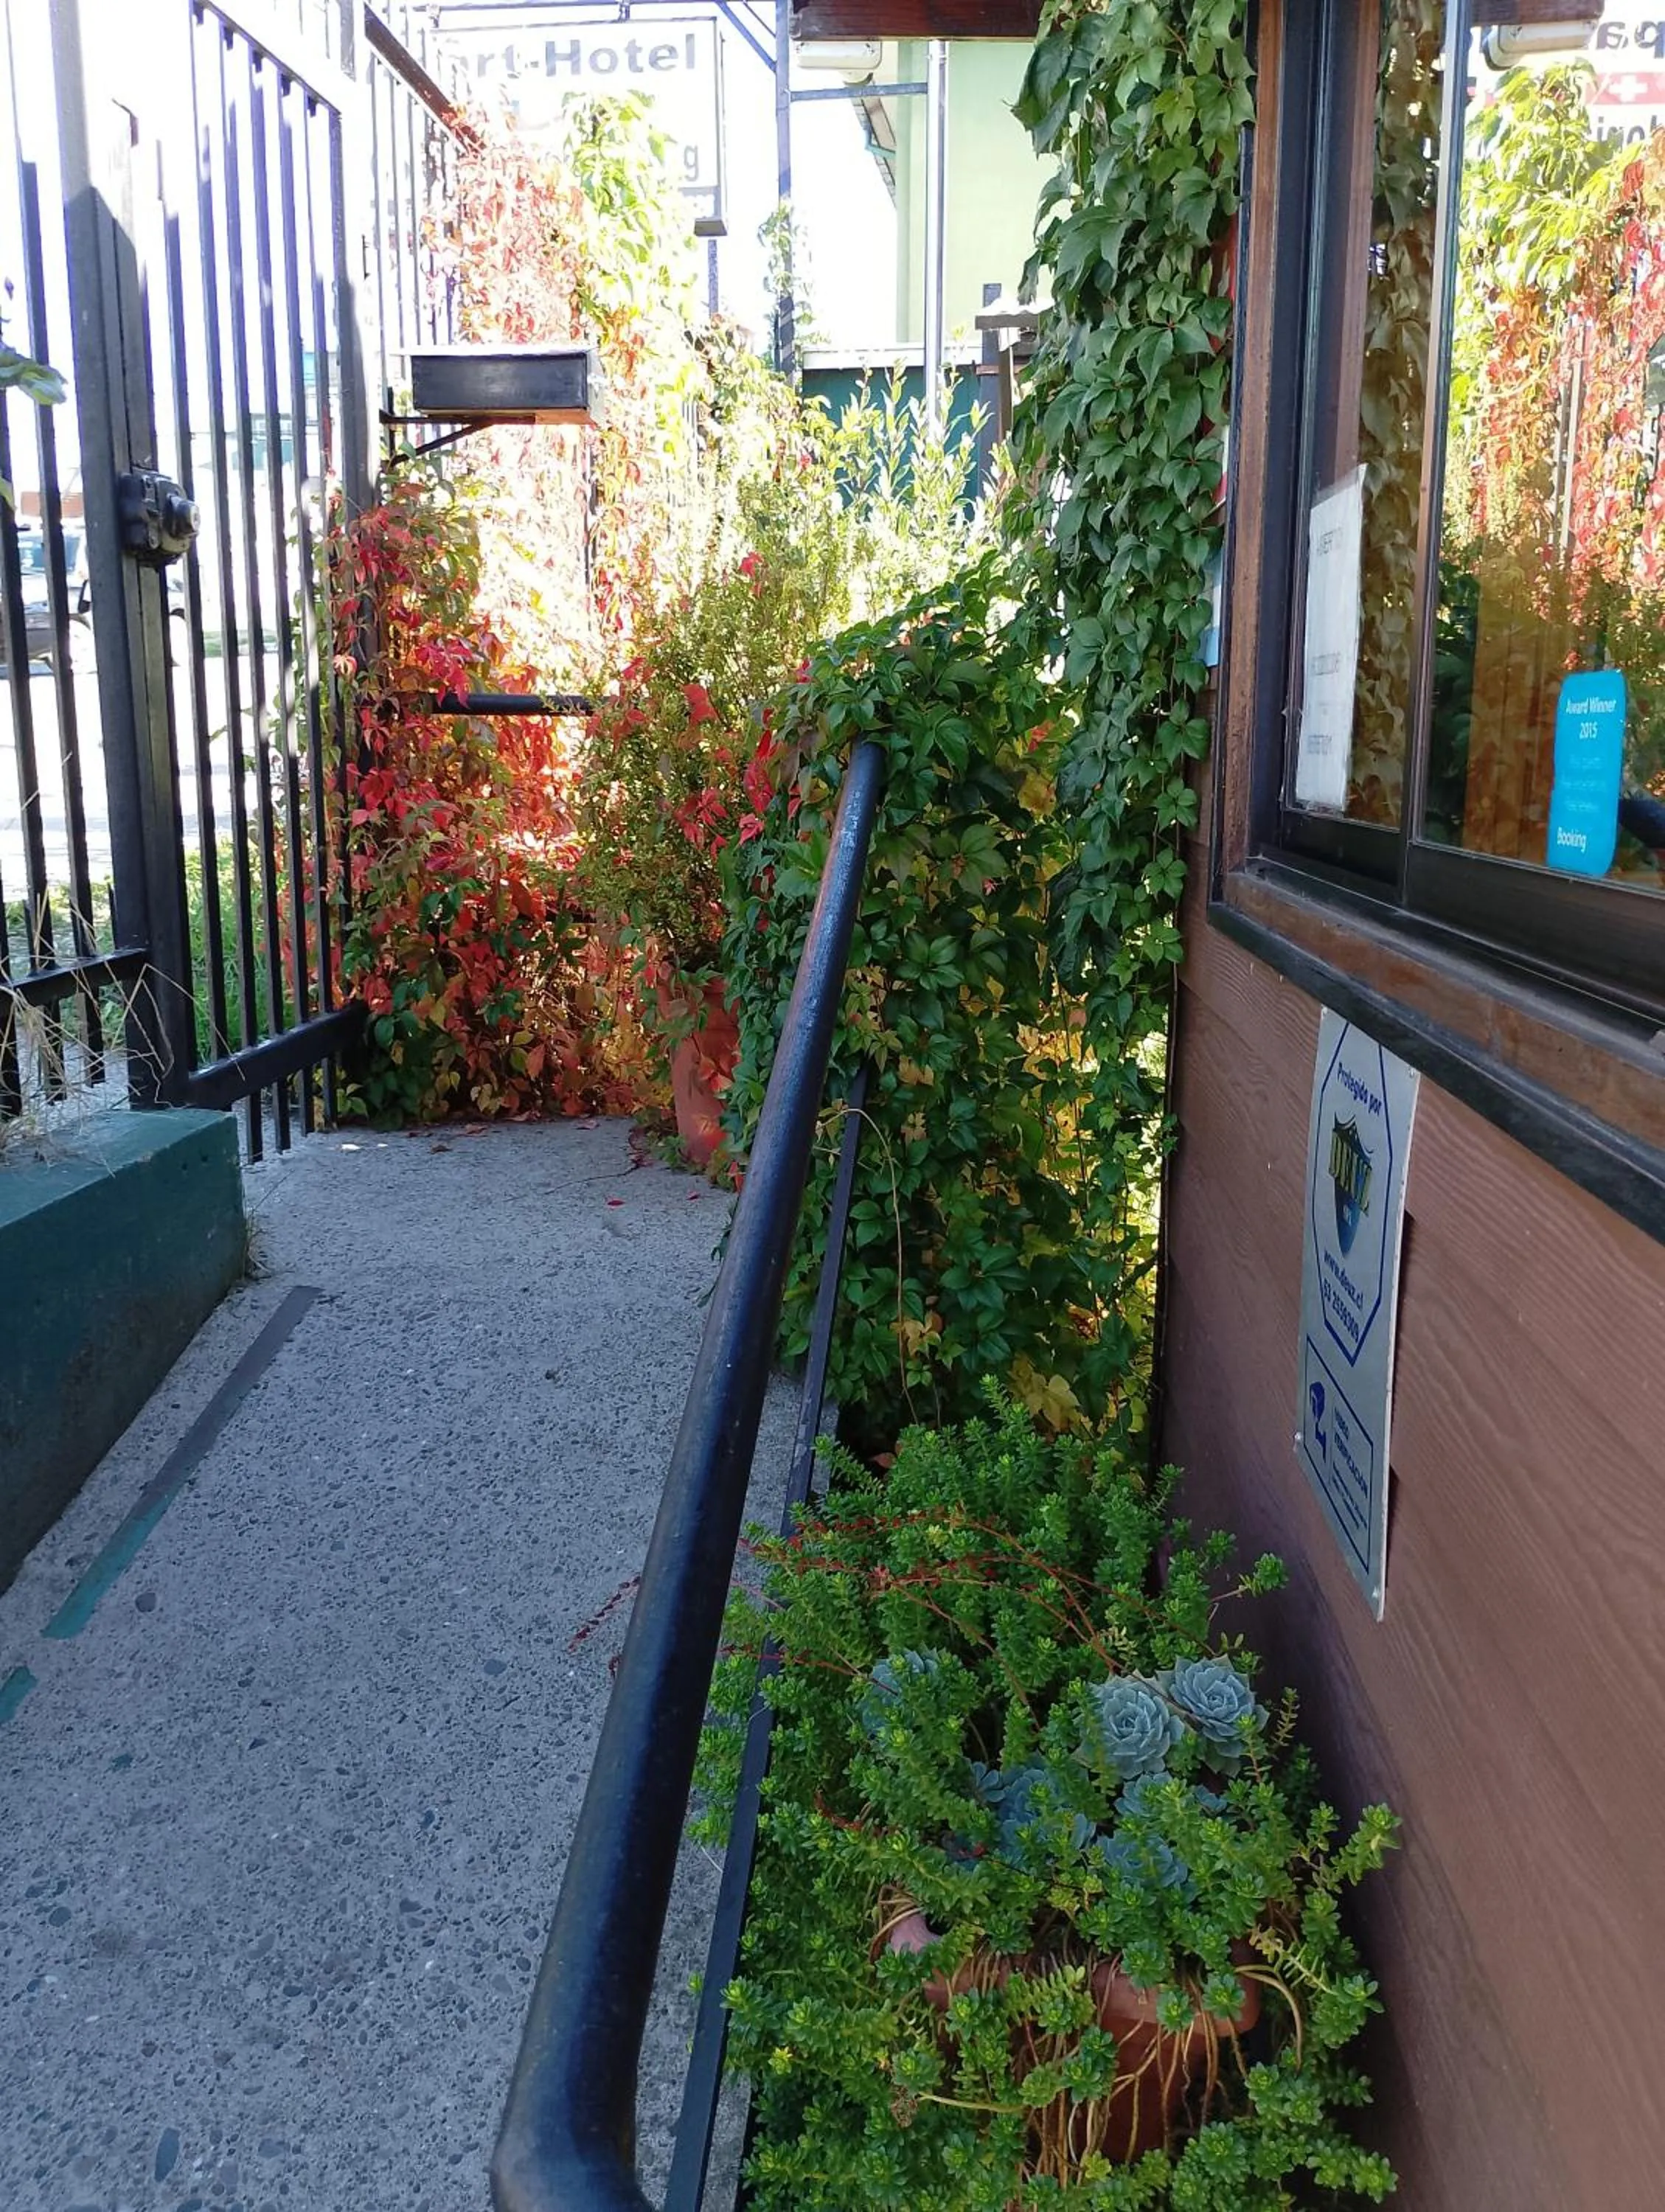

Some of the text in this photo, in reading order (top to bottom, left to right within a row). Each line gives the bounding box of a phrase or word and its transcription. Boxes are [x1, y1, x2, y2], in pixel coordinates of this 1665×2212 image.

[1565, 696, 1617, 715] Award Winner
[1579, 721, 1598, 740] 2015
[1368, 1093, 1382, 1117] por
